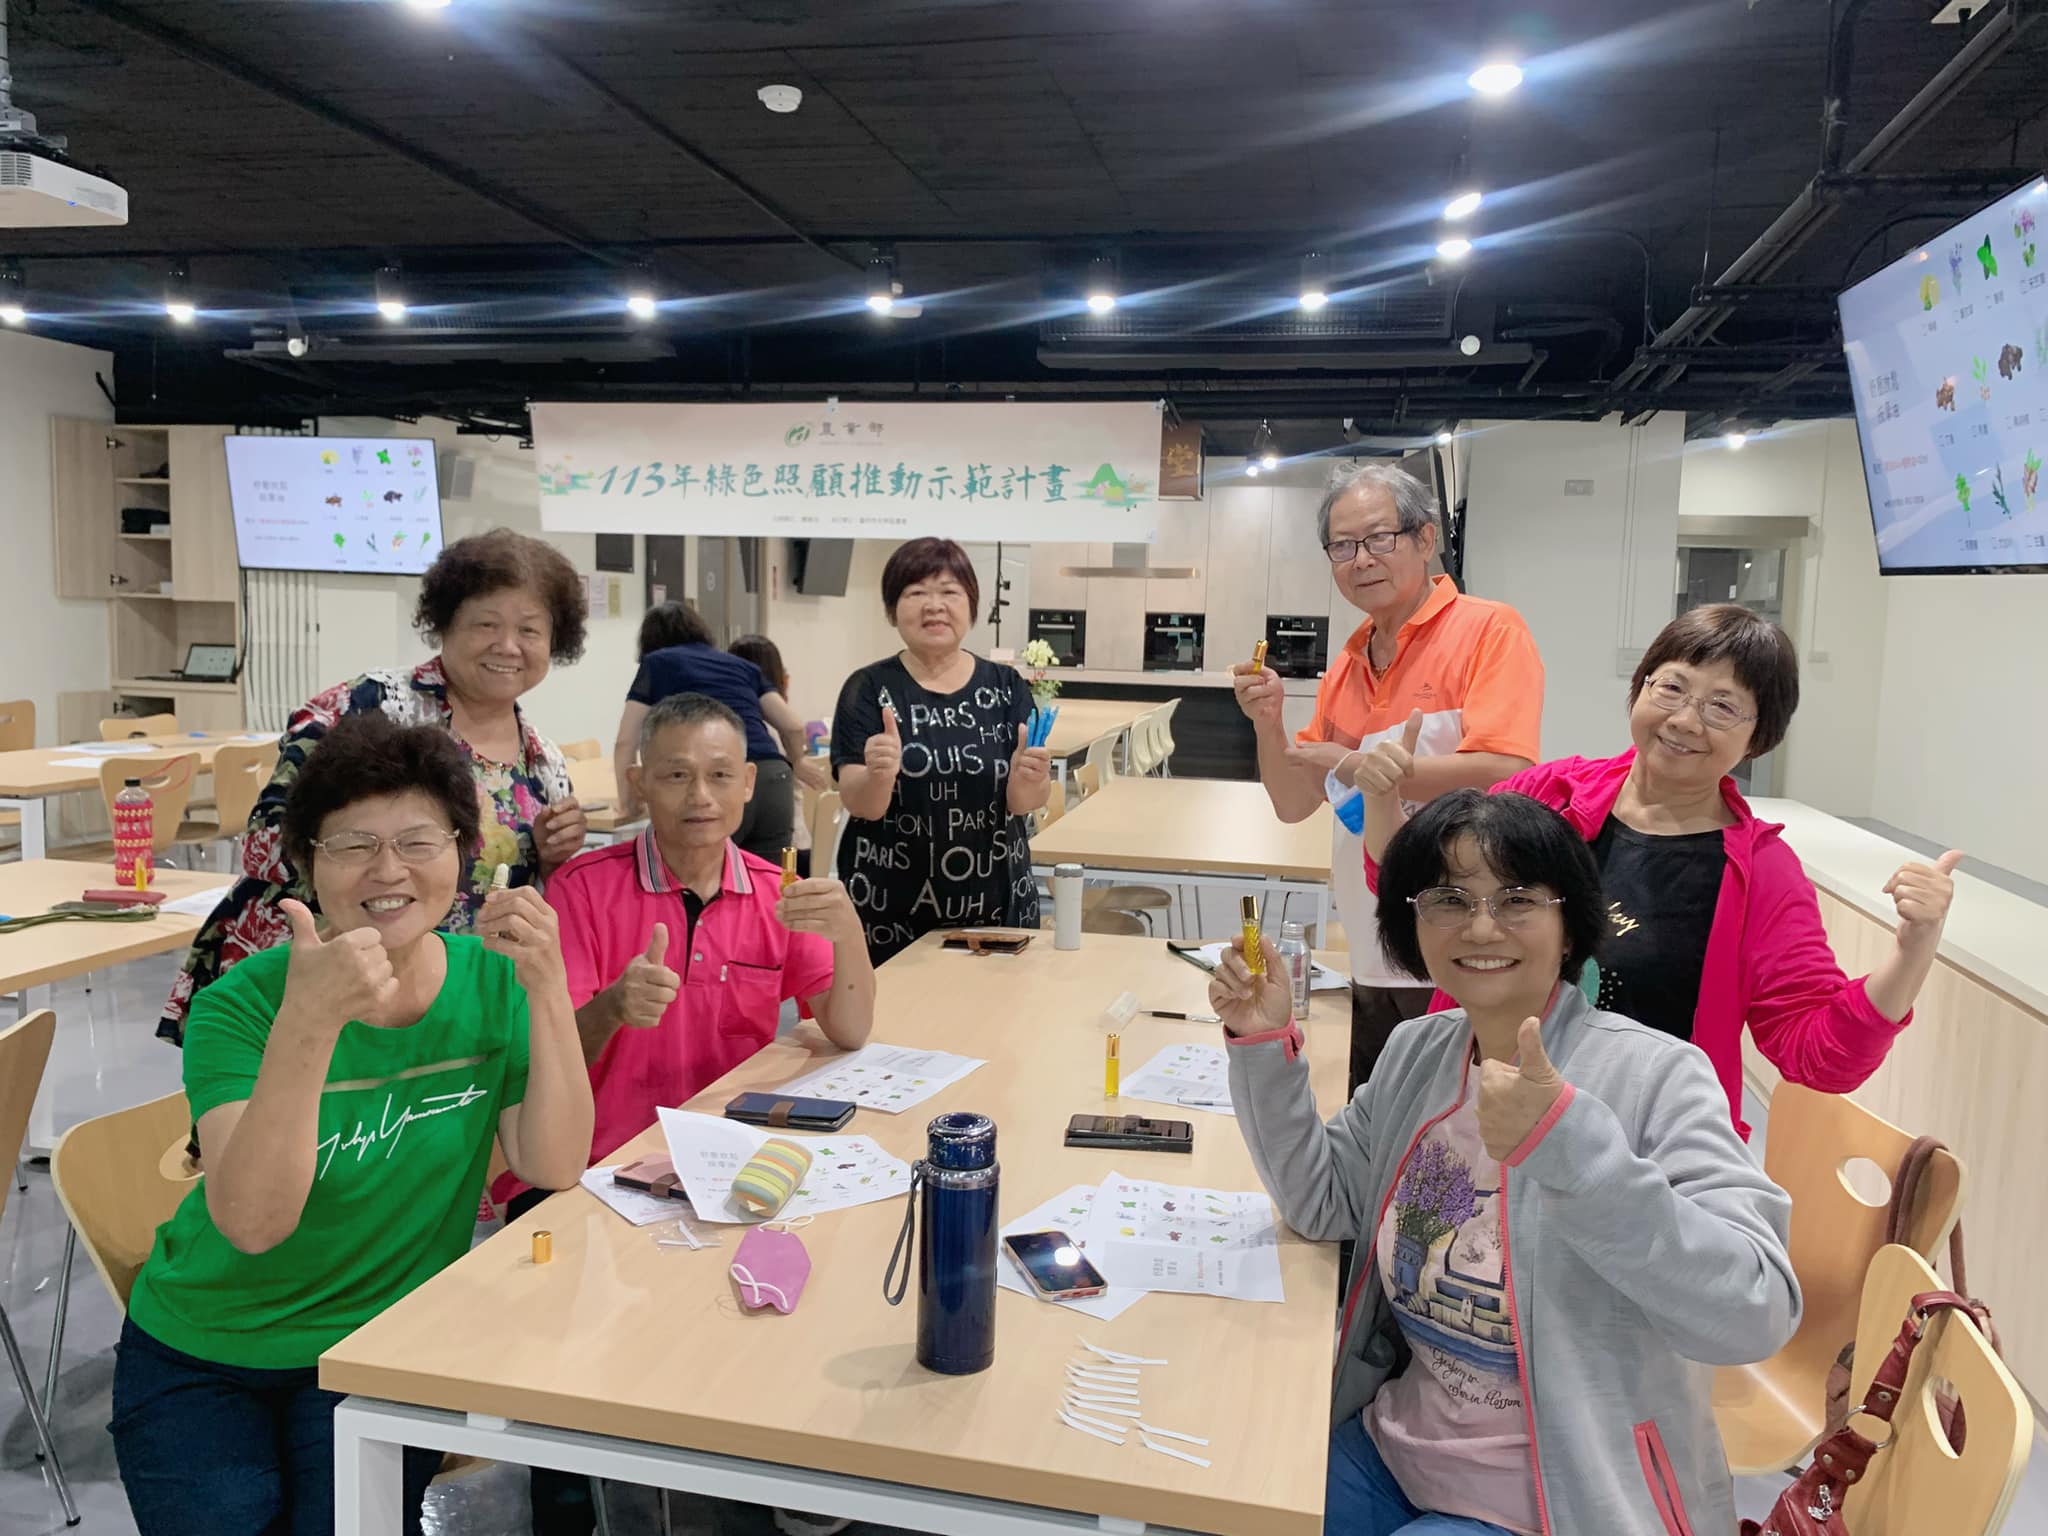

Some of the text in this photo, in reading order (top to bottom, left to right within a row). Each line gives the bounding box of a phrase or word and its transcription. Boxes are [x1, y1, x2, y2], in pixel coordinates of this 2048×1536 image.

[599, 462, 1071, 502] 113年綠色照顧推動示範計畫
[853, 836, 911, 870] PARIS
